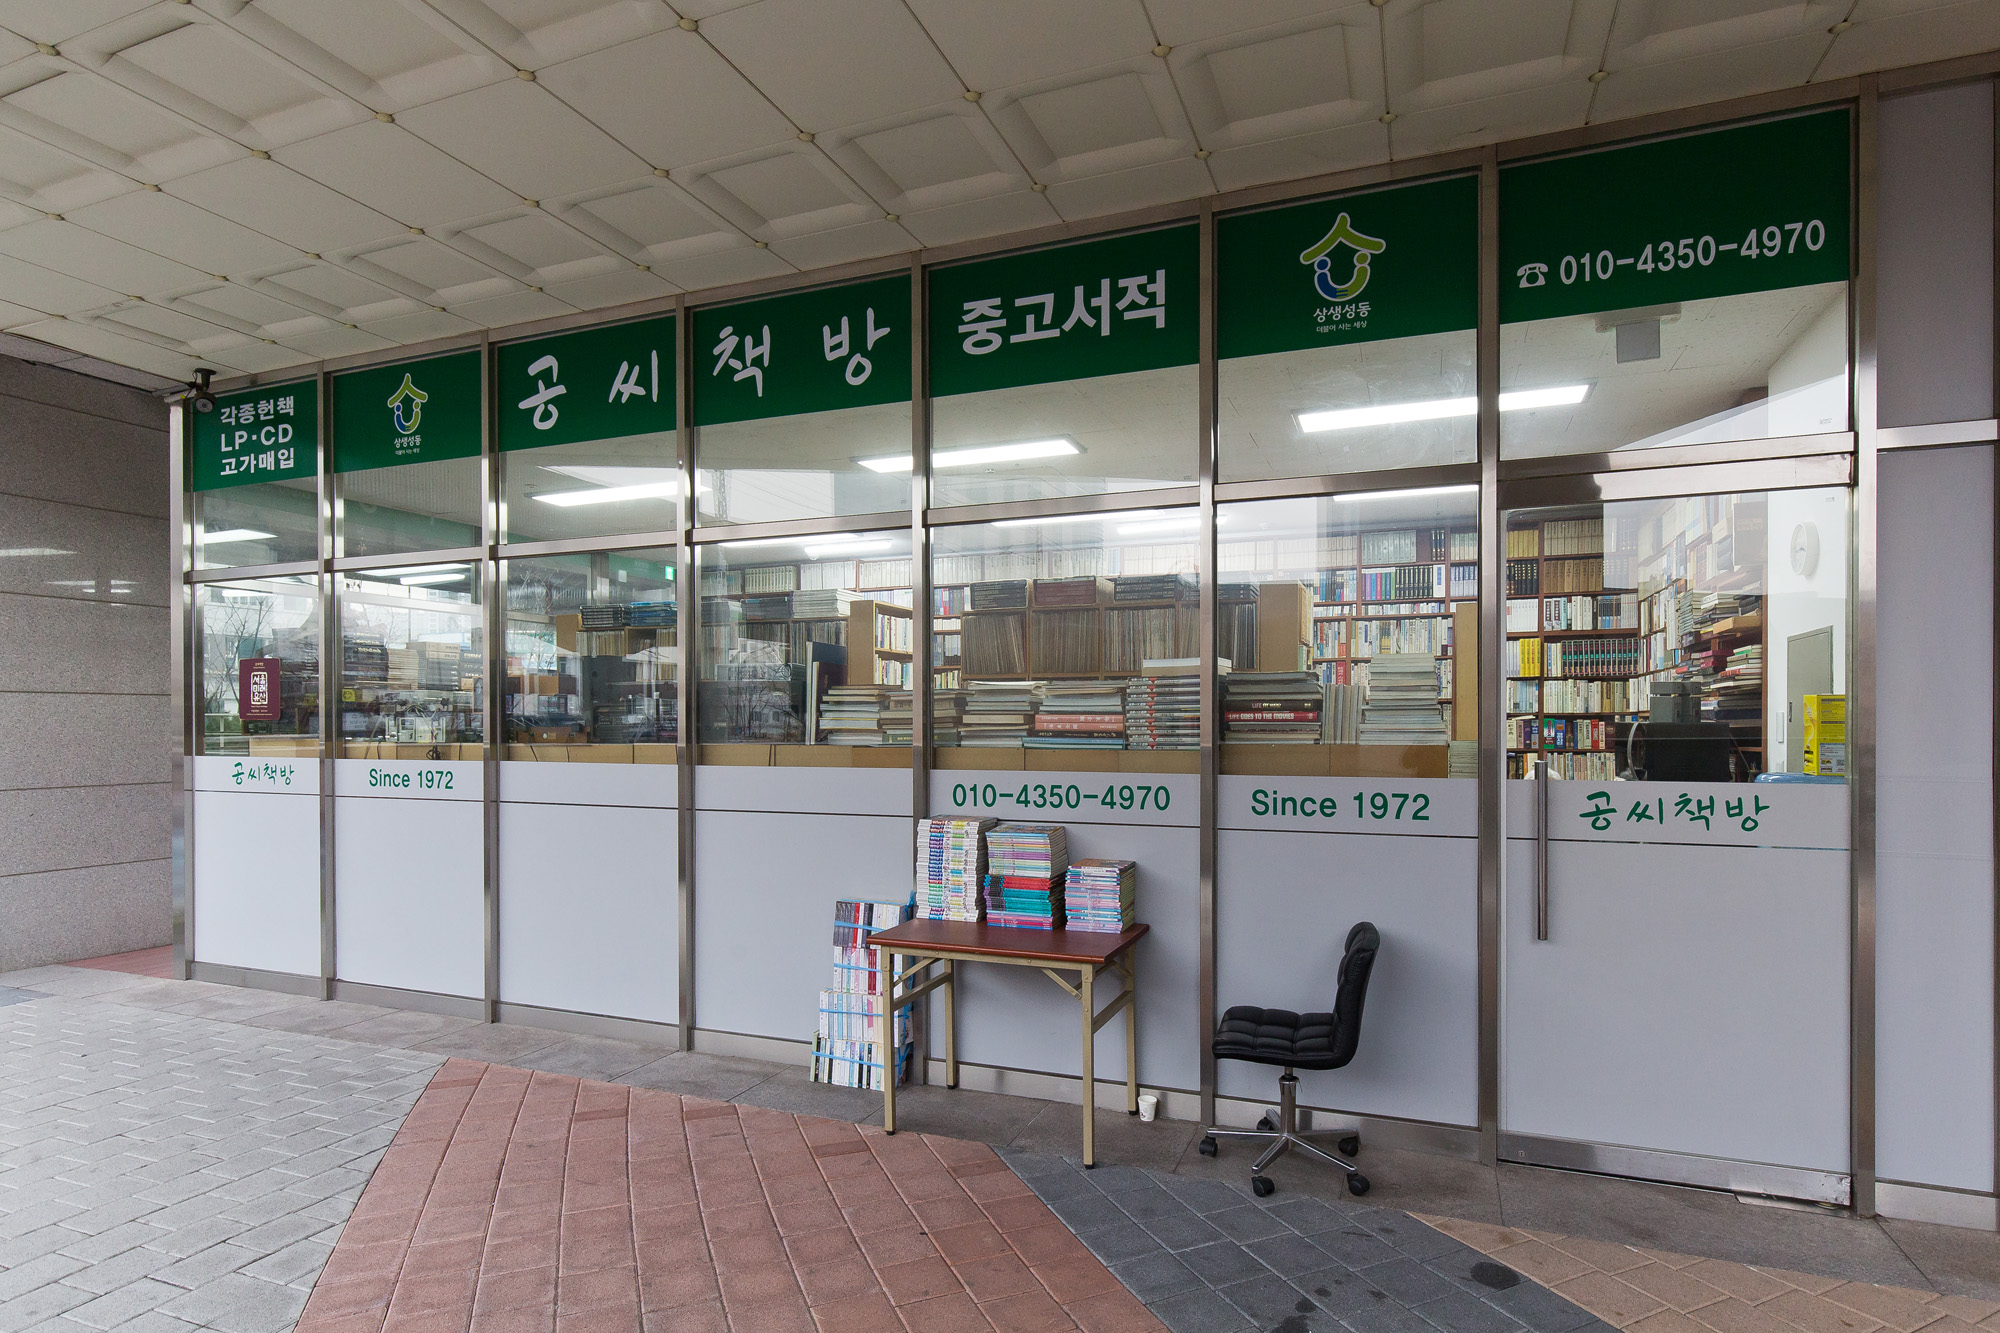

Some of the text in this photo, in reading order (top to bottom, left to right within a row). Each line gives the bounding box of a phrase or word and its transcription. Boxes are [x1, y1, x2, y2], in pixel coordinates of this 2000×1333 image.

[1559, 219, 1826, 285] 010-4350-4970
[958, 269, 1165, 355] 중고서적
[1313, 301, 1371, 323] 상생성동
[220, 396, 294, 426] 각종헌책
[394, 435, 421, 448] 상생성동
[220, 447, 294, 476] 고가매입
[253, 674, 266, 684] 서울
[252, 692, 266, 702] 유산
[231, 762, 295, 785] 공씨책방
[368, 768, 454, 789] Since 1972
[952, 783, 1171, 811] 010-4350-4970
[1251, 789, 1430, 821] Since 1972
[1579, 791, 1770, 832] 공씨책방
